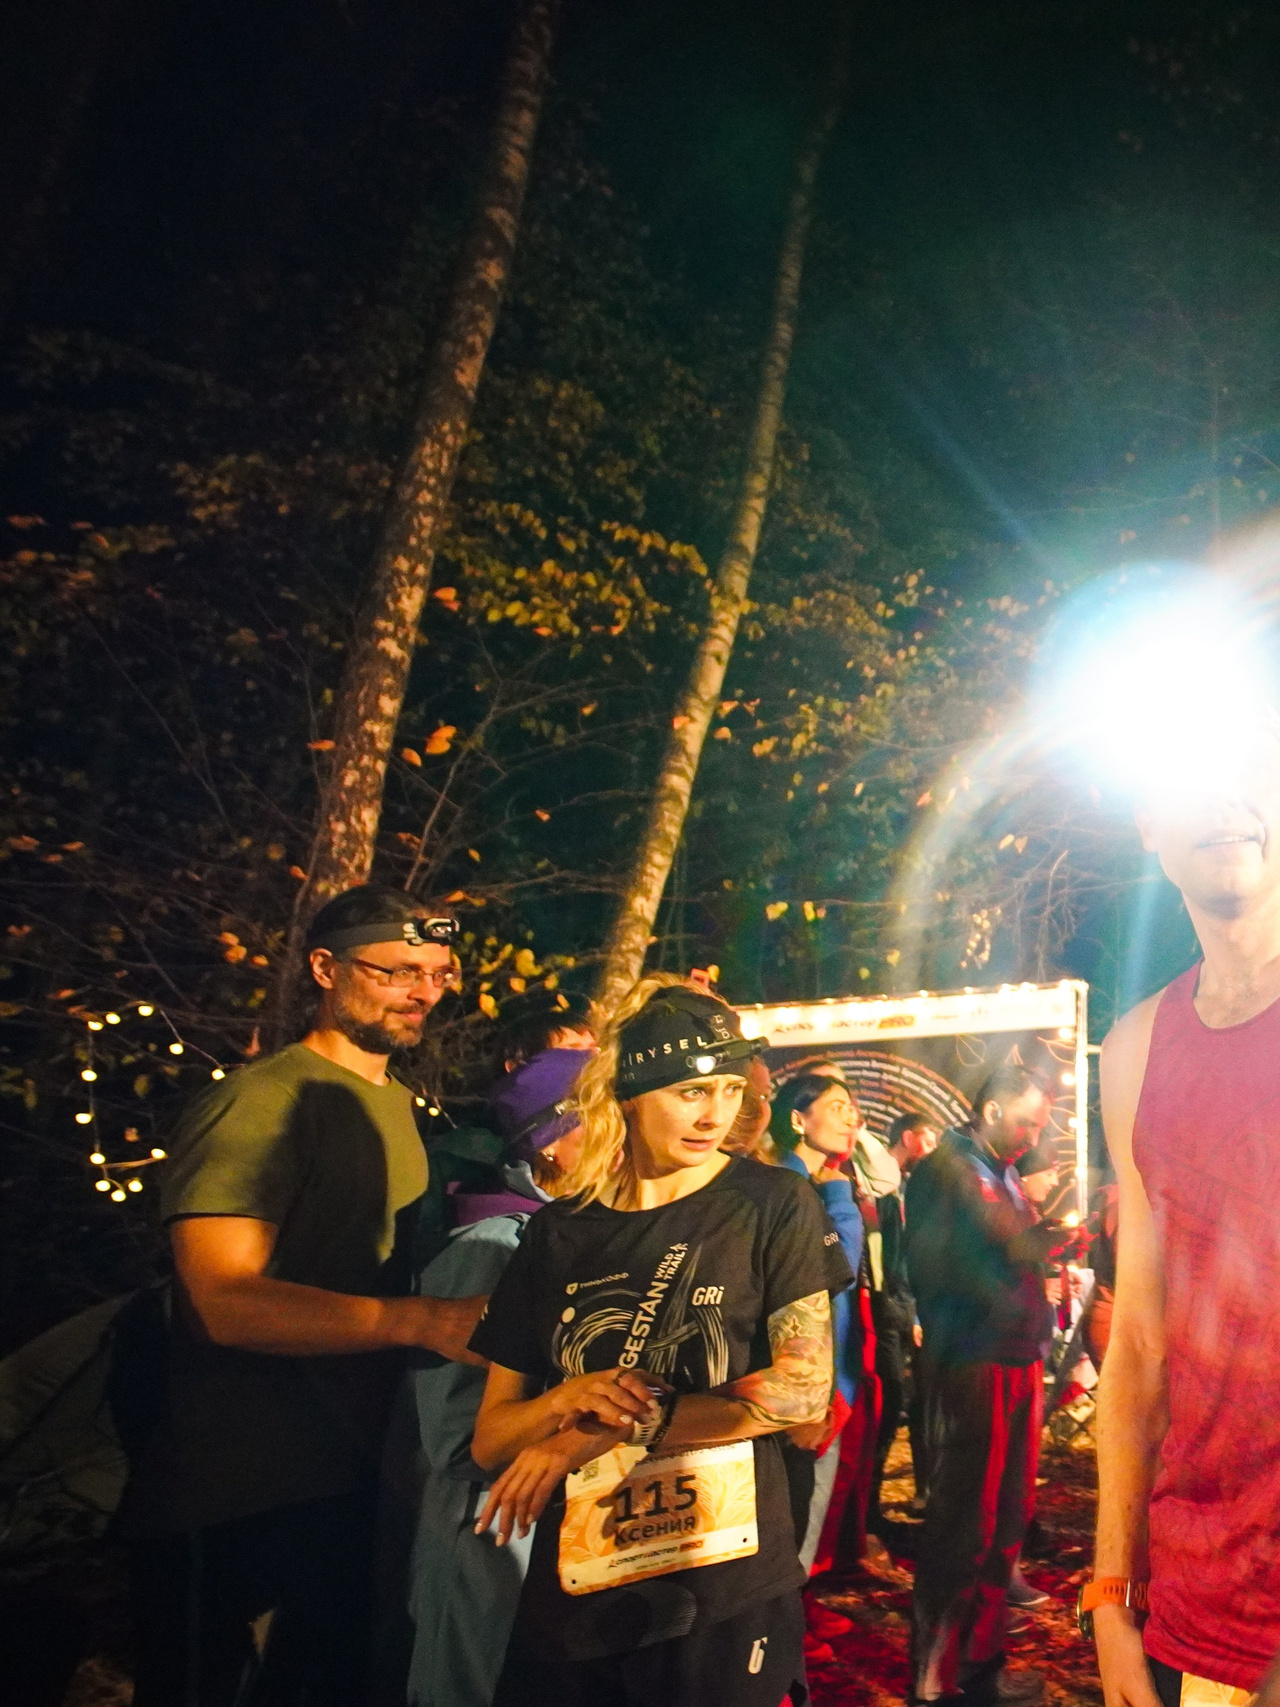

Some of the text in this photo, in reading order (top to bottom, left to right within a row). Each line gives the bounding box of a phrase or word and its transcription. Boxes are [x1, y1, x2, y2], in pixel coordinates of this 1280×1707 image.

[824, 1231, 839, 1247] GRi
[653, 1251, 674, 1280] WILD
[664, 1250, 686, 1281] TRAIL
[691, 1286, 725, 1306] GRi
[614, 1474, 698, 1523] 115
